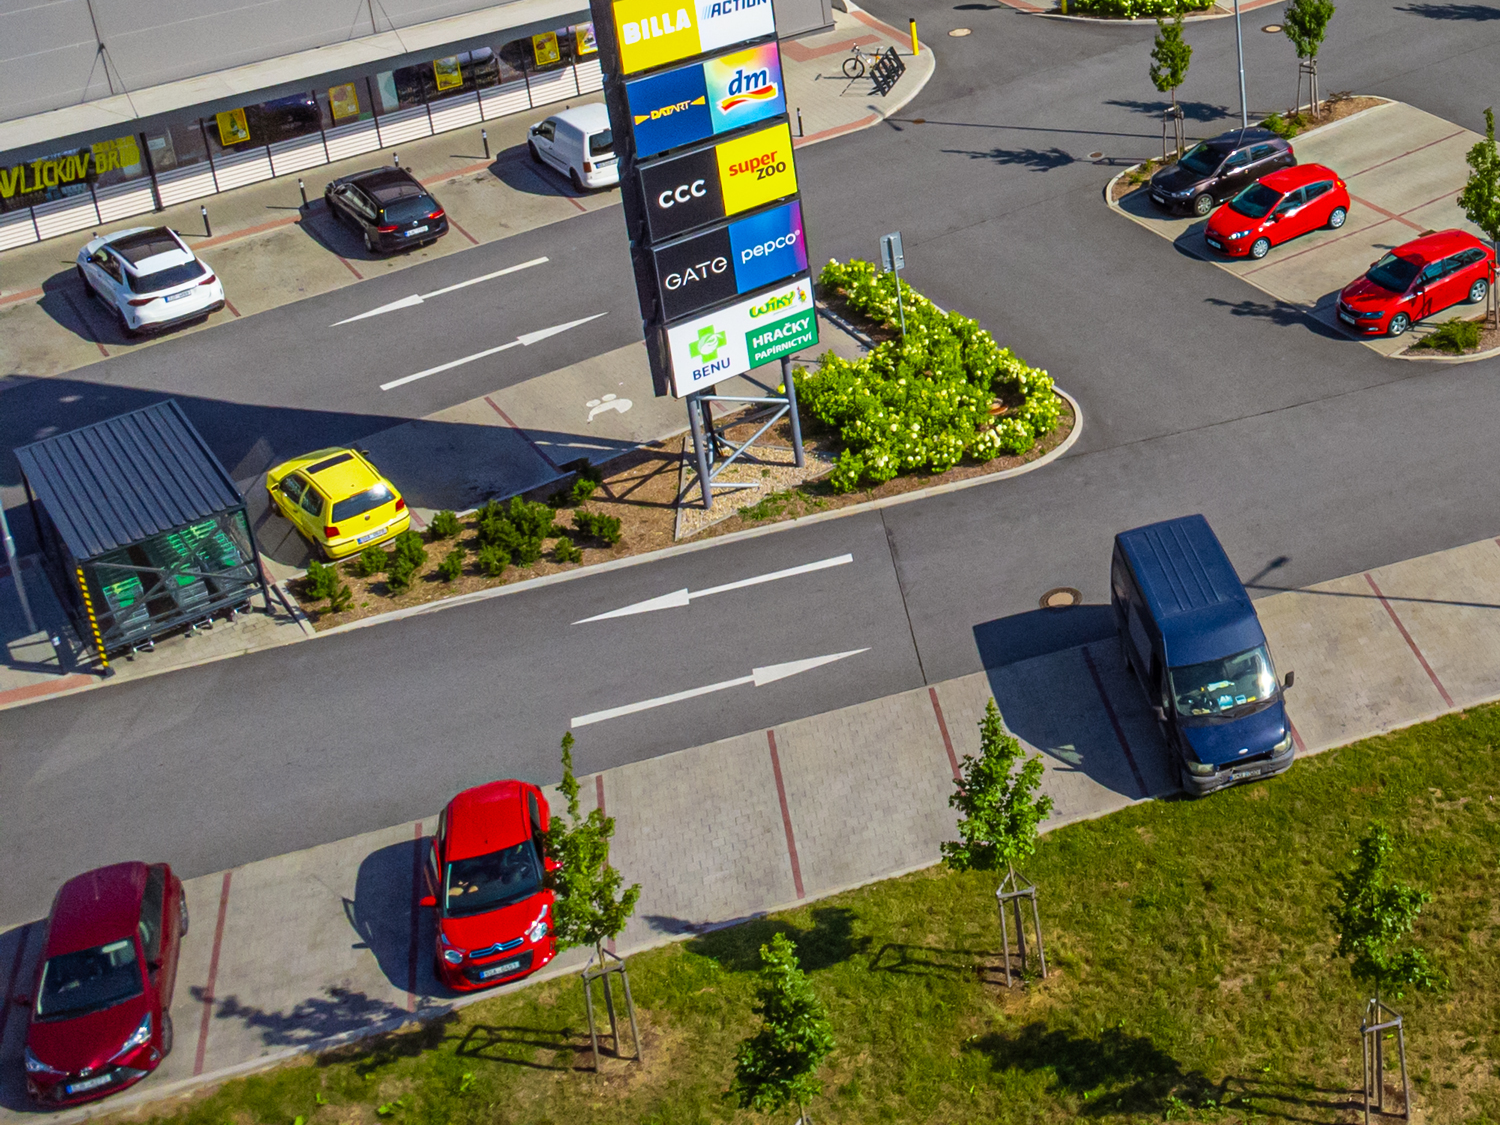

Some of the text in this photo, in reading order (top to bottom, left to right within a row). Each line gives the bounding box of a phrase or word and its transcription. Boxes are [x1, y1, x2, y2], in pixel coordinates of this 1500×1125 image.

[622, 7, 692, 45] BILLA
[728, 69, 768, 96] dm
[650, 100, 691, 120] DATART
[729, 151, 778, 177] super
[658, 180, 707, 209] CCC
[741, 235, 797, 264] pepco
[752, 317, 810, 348] HRAČKY
[754, 331, 813, 361] PAPÍRNICTVÍ
[692, 357, 731, 381] BENU
